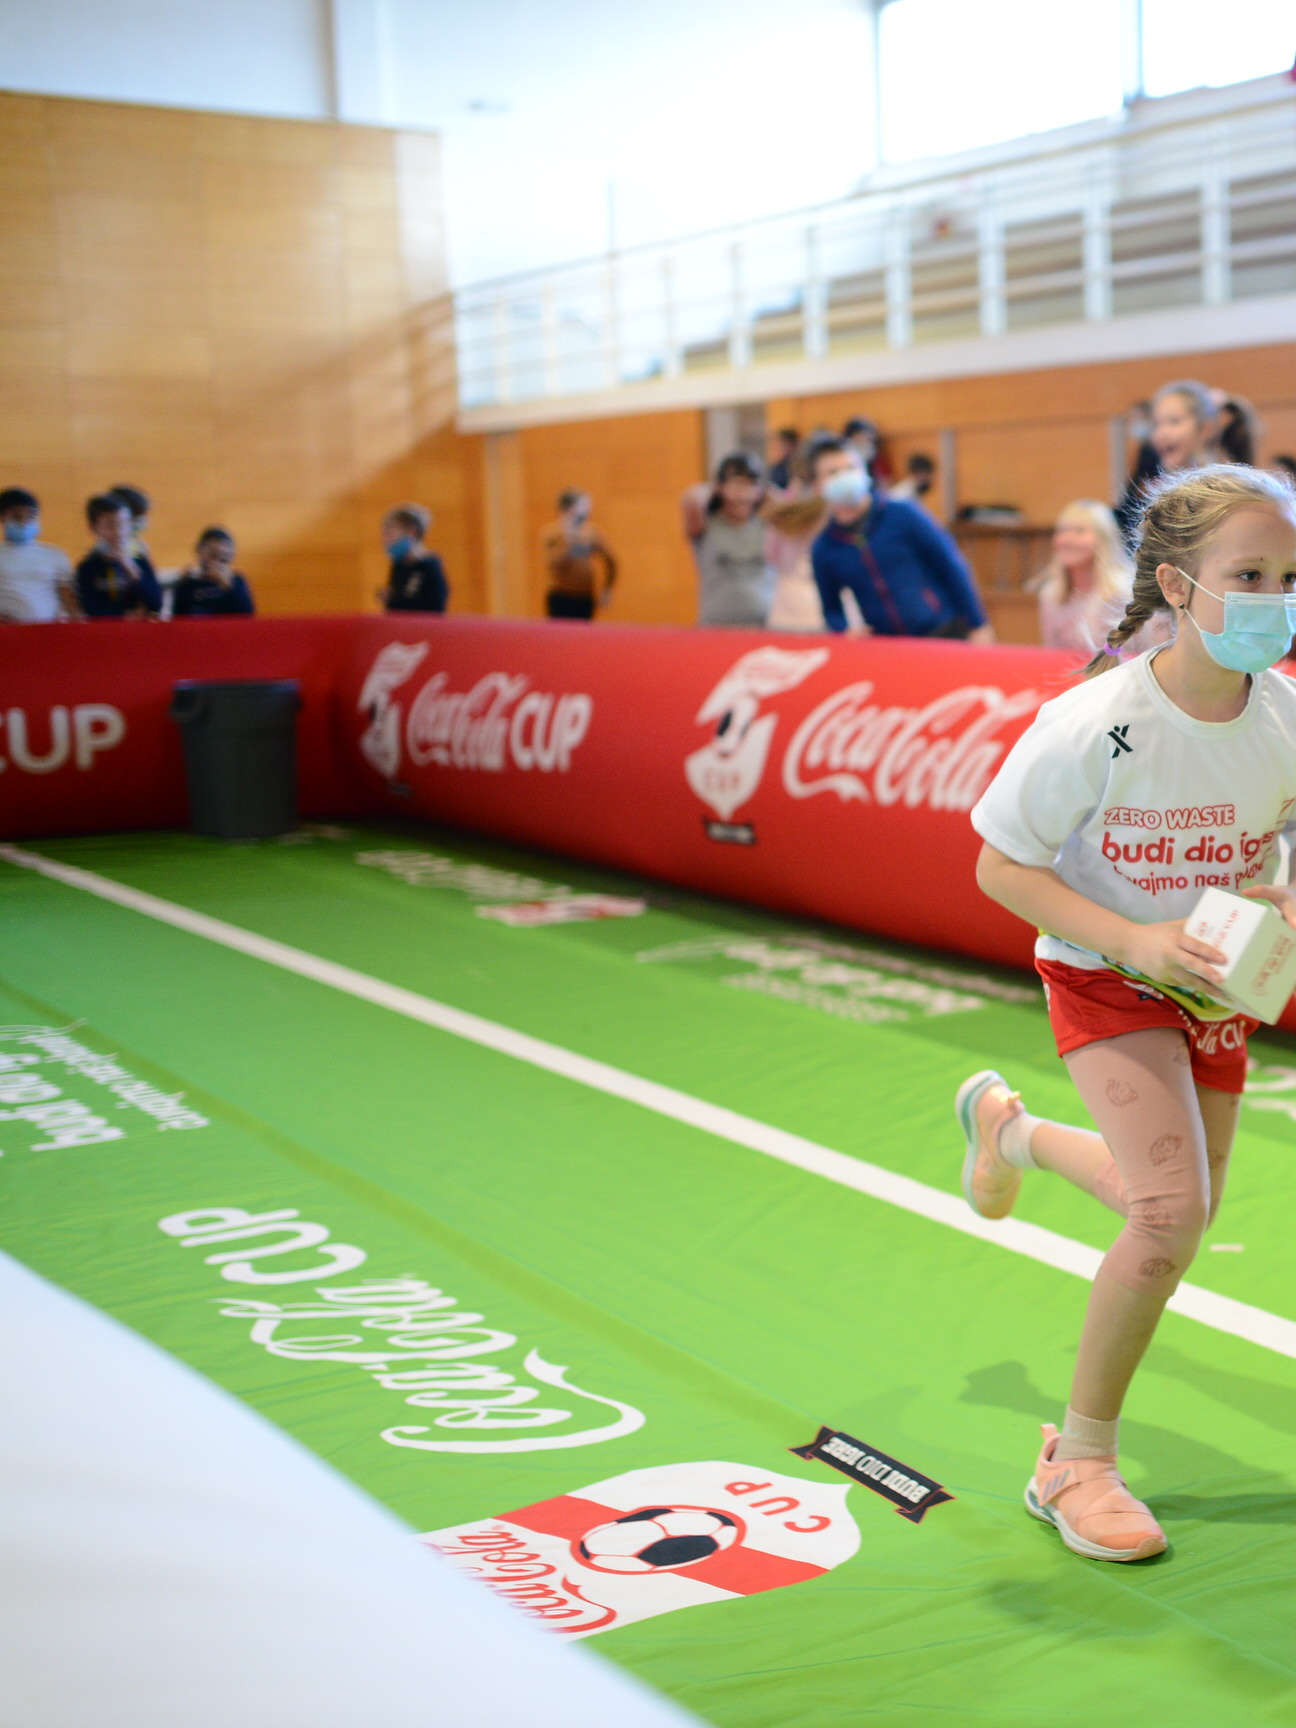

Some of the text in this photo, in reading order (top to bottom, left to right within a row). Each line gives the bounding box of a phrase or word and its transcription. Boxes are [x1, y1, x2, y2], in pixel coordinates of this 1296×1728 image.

[0, 702, 127, 775] UP
[510, 691, 592, 773] CUP
[1104, 803, 1235, 831] ZERO WASTE
[1102, 831, 1175, 865] budi
[1184, 835, 1234, 864] dio
[1195, 872, 1230, 889] naš
[158, 1207, 367, 1285] CUP
[820, 1436, 931, 1504] BUDI DIO IGRE
[723, 1480, 832, 1534] CUP
